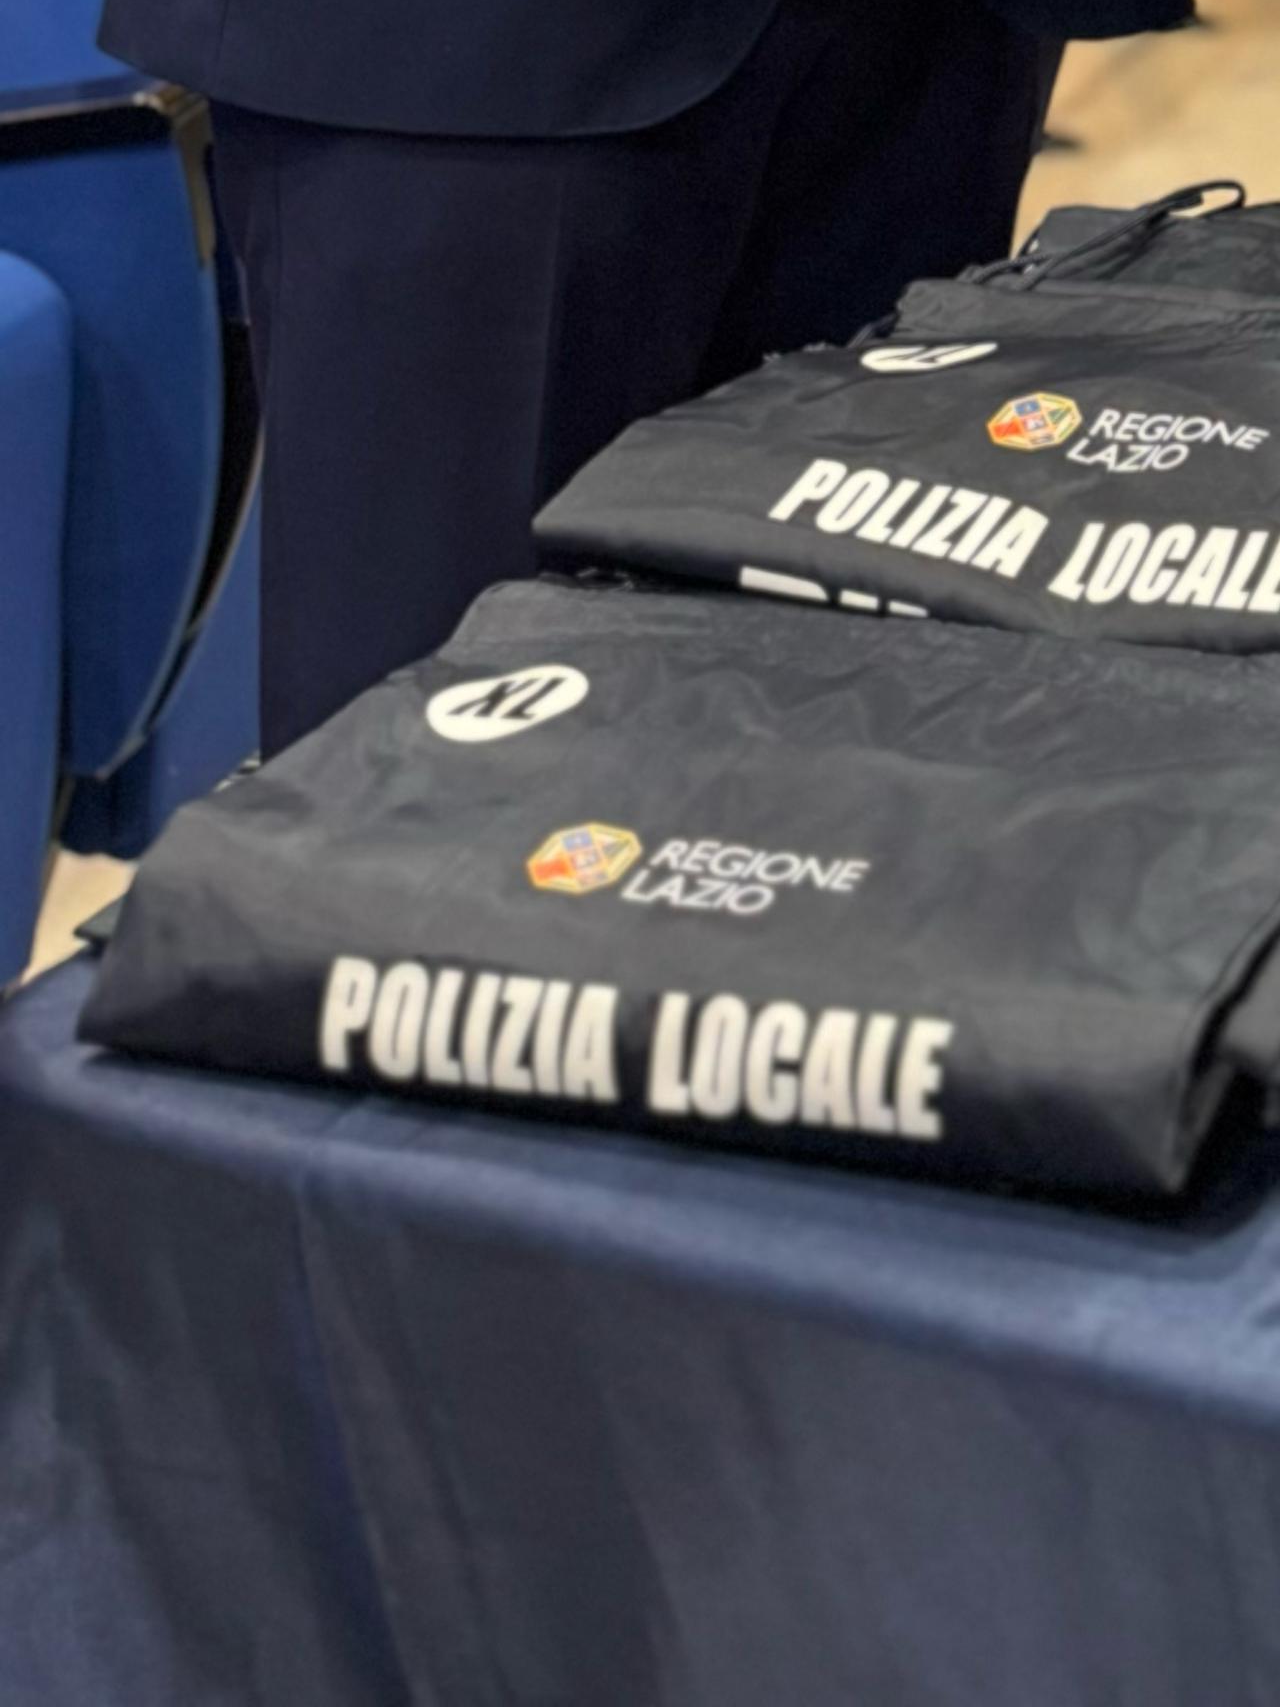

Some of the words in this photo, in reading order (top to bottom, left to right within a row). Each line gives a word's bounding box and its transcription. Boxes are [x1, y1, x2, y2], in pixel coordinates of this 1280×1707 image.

[1088, 408, 1271, 451] REGIONE
[1066, 437, 1190, 473] LAZIO
[768, 459, 1049, 579] POLIZIA
[447, 676, 567, 720] XL
[648, 839, 870, 892] REGIONE
[620, 867, 775, 915] LAZIO
[320, 954, 620, 1101] POLIZIA
[647, 988, 956, 1139] LOCALE
